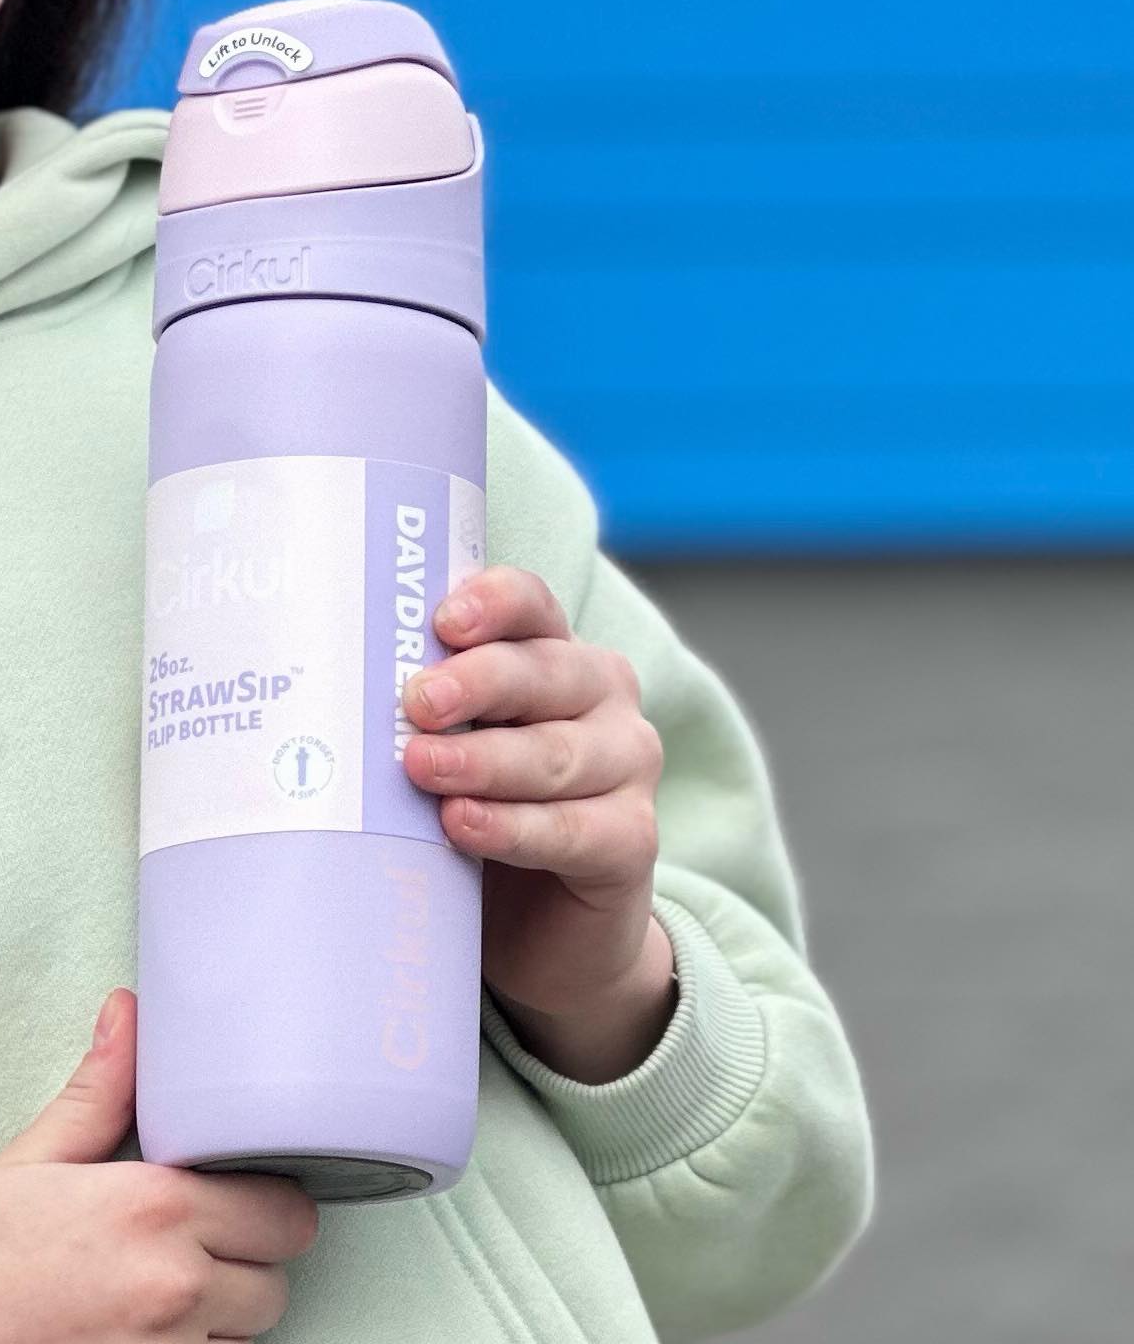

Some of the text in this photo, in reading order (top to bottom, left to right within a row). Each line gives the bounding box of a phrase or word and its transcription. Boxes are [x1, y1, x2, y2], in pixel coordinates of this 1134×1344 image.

[208, 32, 302, 67] Lift to Unlock
[184, 246, 311, 299] Cirkul
[150, 543, 294, 619] Cirkul
[147, 709, 263, 752] FLIP BOTTLE
[380, 867, 430, 1073] Cirkul
